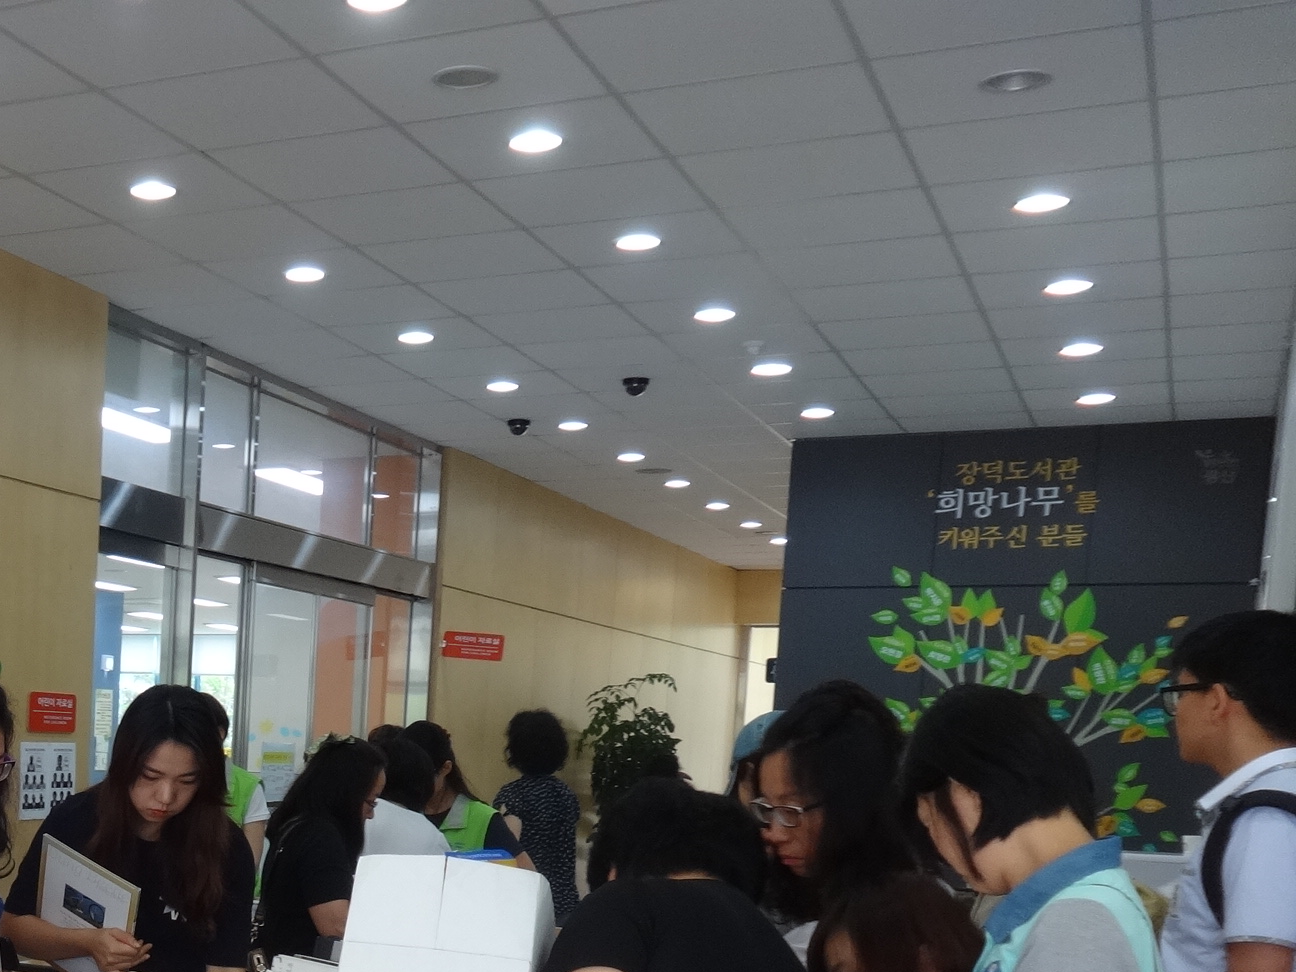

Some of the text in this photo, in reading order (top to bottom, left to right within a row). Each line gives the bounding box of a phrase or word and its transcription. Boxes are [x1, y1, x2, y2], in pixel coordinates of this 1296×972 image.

[955, 456, 1083, 486] 장덕도서관
[937, 523, 1089, 550] 키워주신 분들
